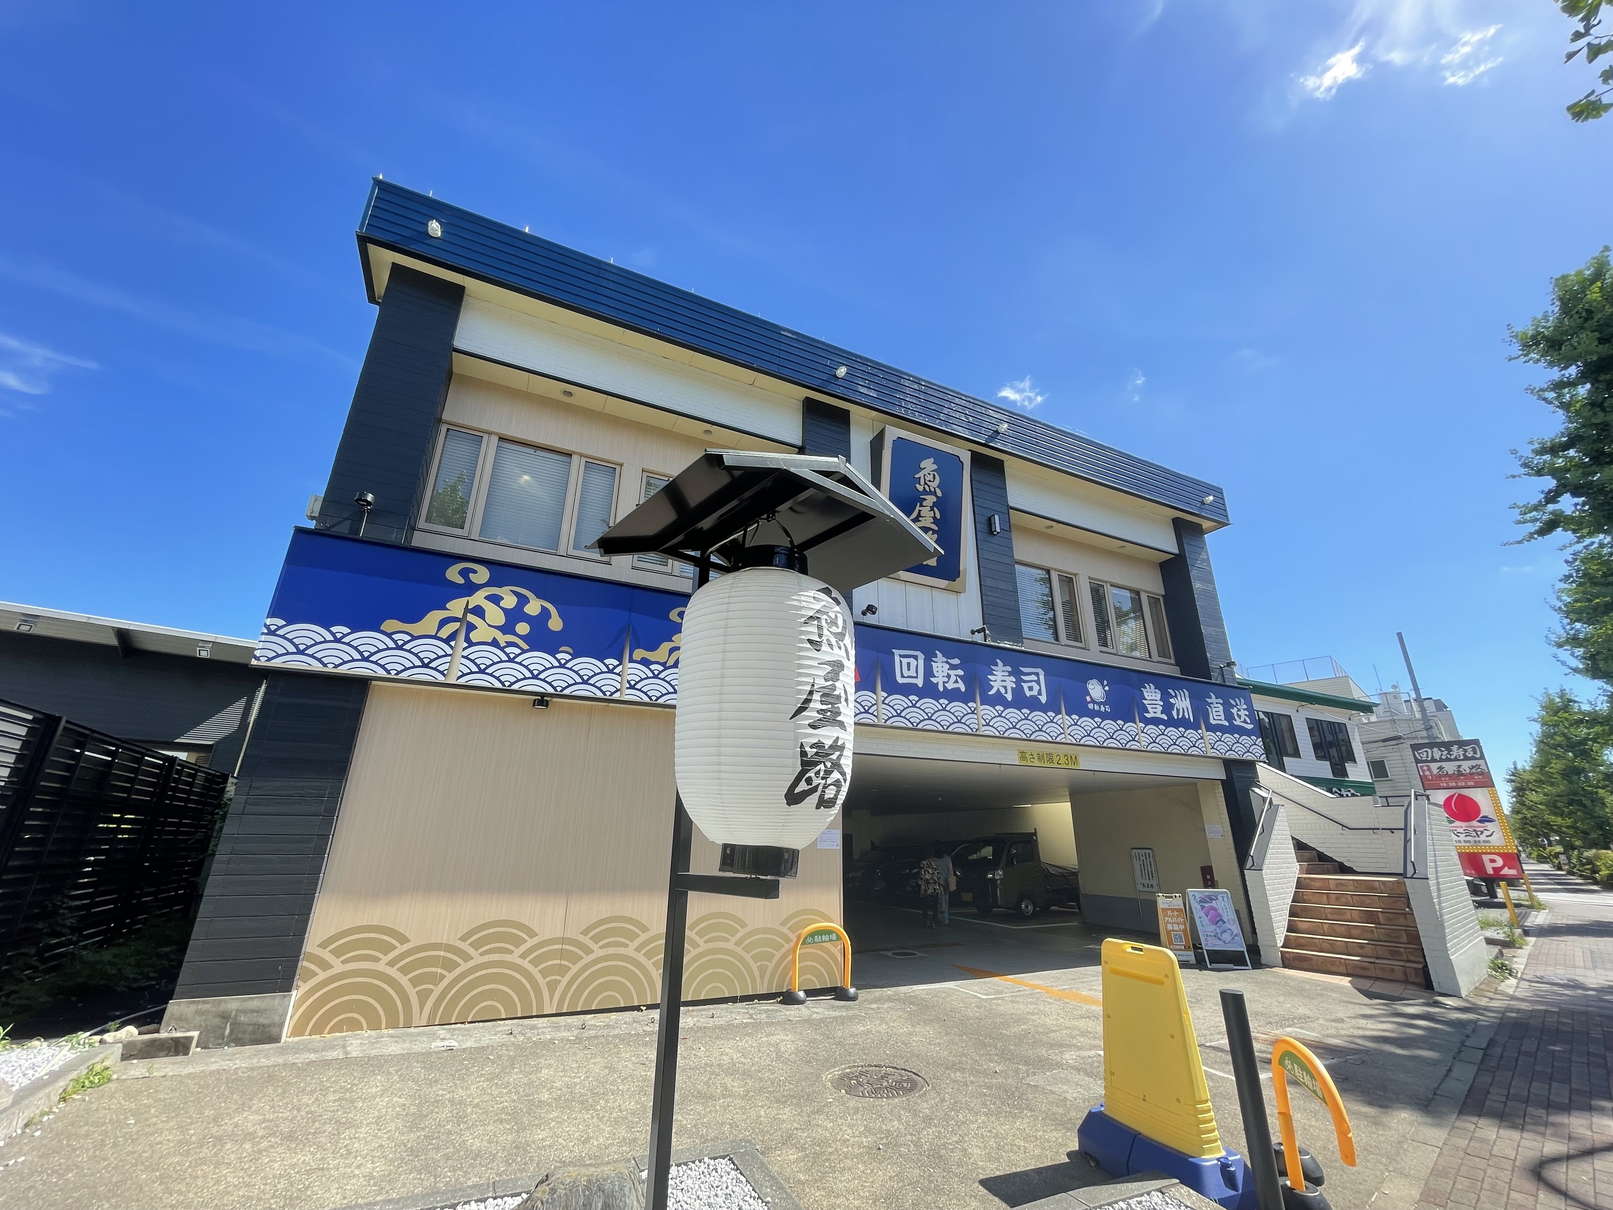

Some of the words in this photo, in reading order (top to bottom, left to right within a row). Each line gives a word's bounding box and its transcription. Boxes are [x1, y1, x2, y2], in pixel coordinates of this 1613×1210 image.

[784, 586, 850, 809] 魚屋路
[1414, 744, 1480, 760] 回転寿司
[1481, 854, 1504, 875] P
